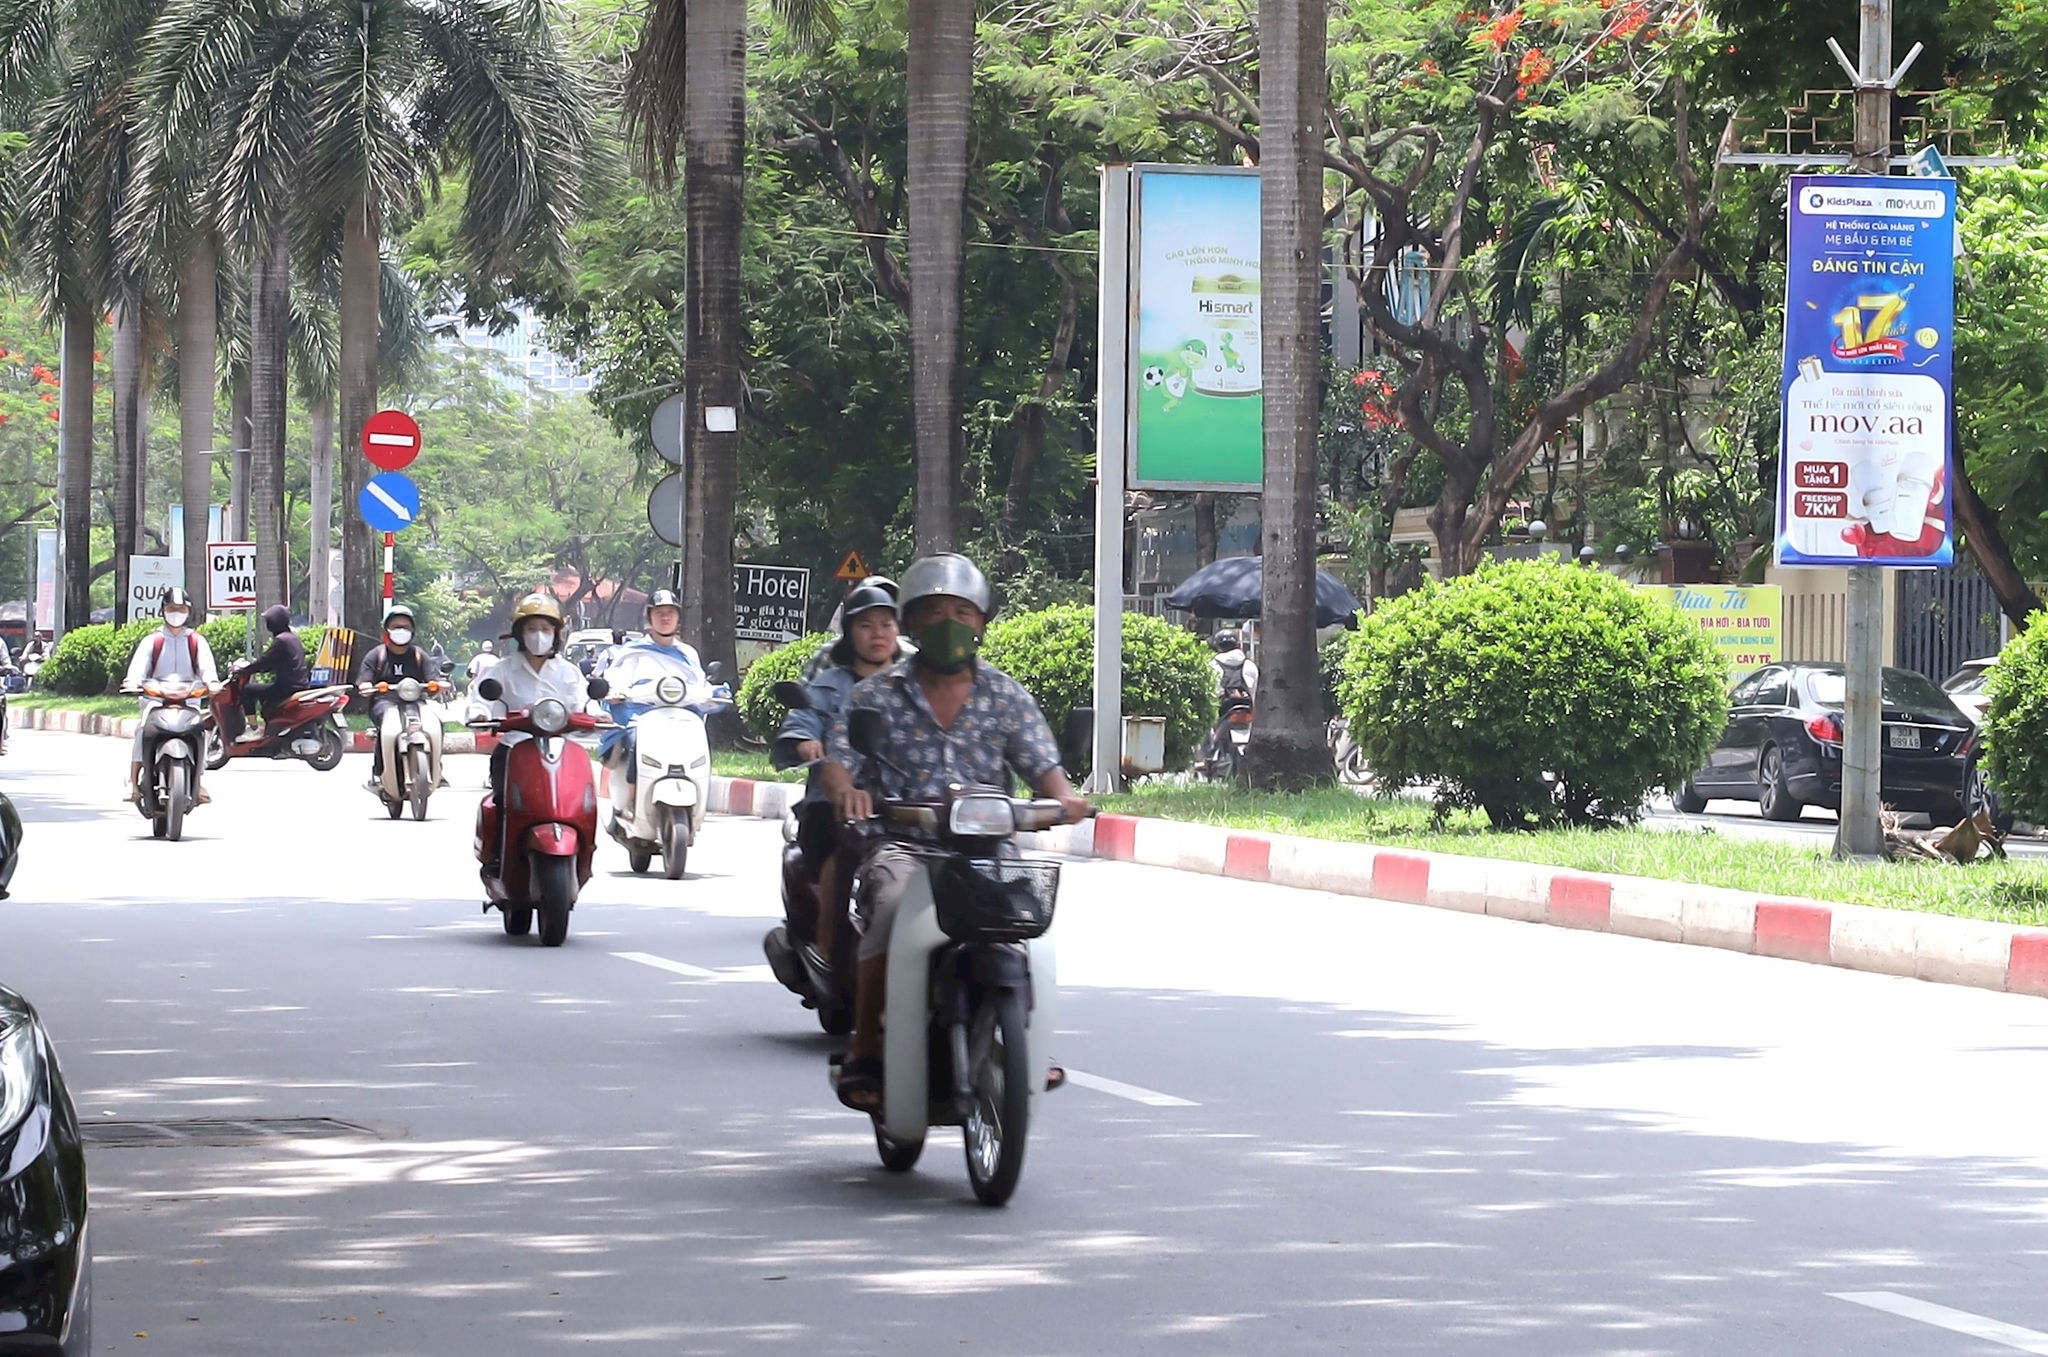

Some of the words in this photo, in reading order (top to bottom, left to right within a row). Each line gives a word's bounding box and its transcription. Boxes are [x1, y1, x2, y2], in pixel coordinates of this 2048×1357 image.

[1881, 236, 1897, 246] EM
[1862, 261, 1887, 274] TIN
[1810, 414, 1923, 435] mov.aa
[1803, 465, 1827, 474] MUA
[1801, 493, 1842, 503] FREESHIP
[1804, 503, 1837, 516] 7KM
[213, 549, 246, 572] CẮT
[228, 576, 257, 593] NA
[748, 569, 805, 599] Hotel
[133, 583, 173, 600] QUÁ
[1737, 655, 1755, 664] CAY
